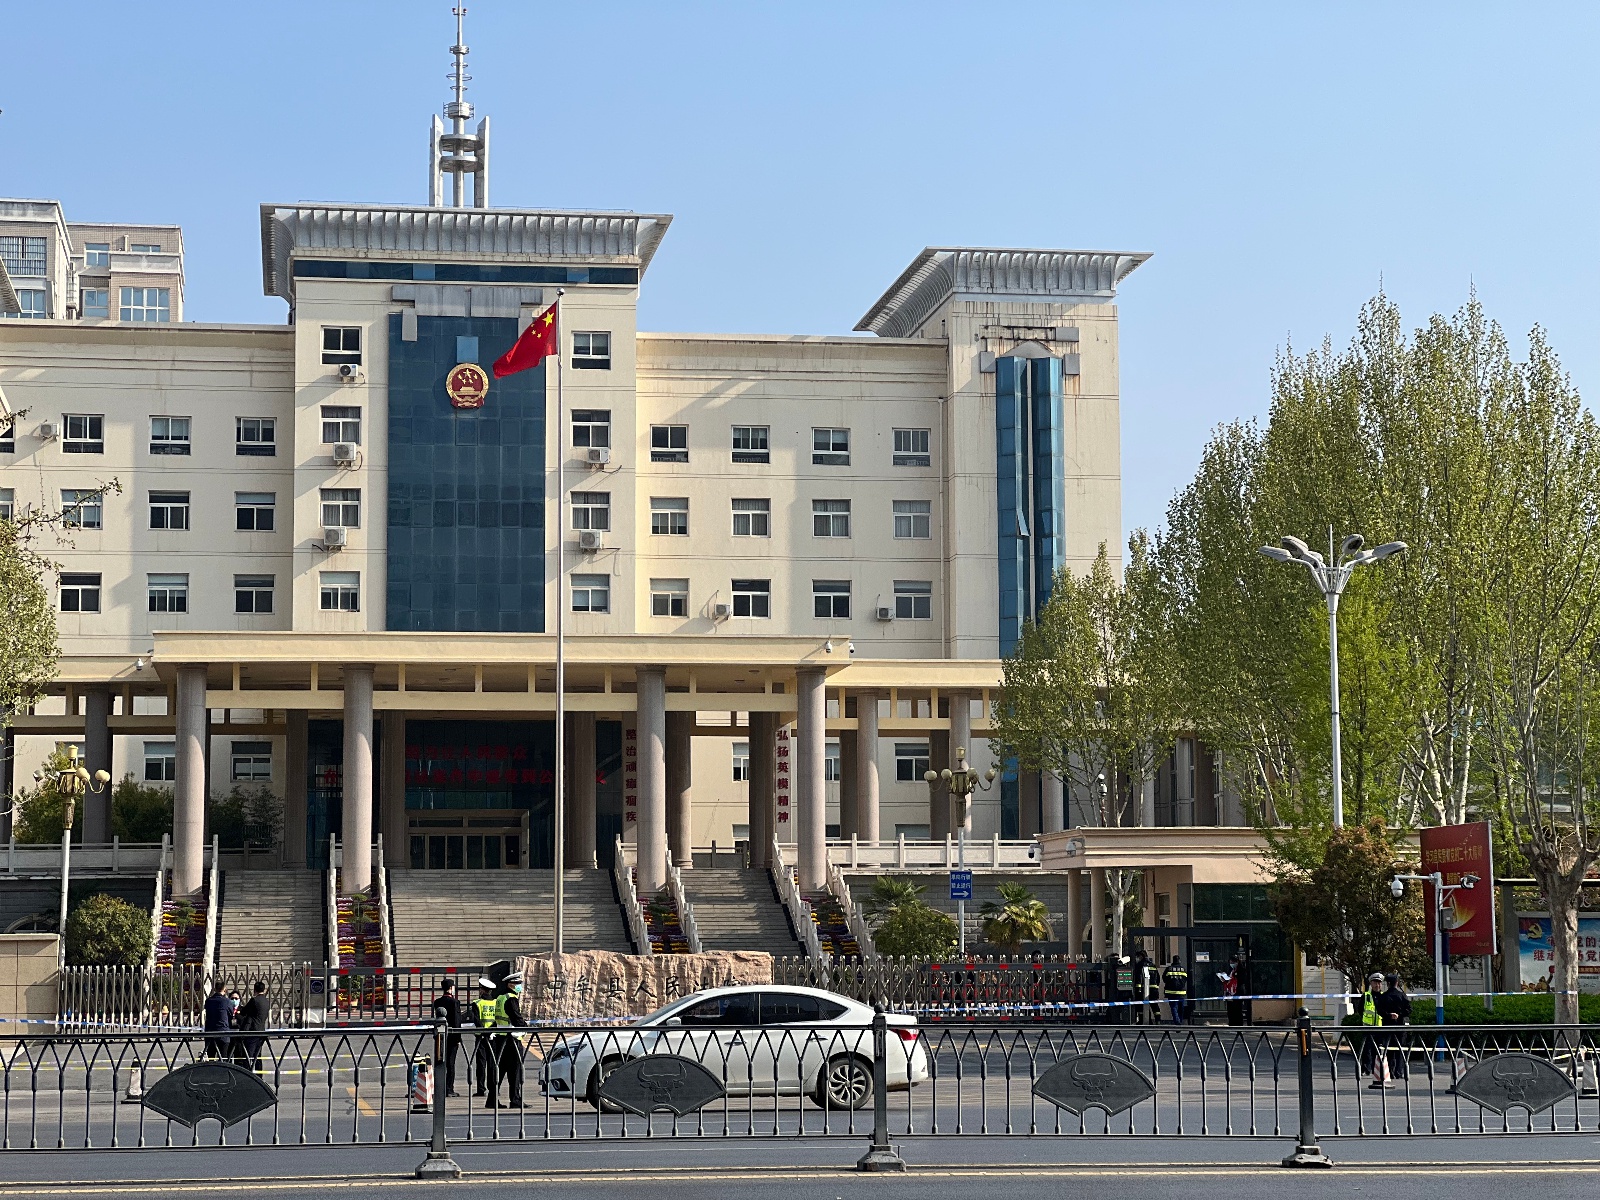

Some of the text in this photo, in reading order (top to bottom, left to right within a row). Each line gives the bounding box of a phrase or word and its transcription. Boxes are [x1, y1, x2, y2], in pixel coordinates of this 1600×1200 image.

[777, 730, 789, 823] 弘扬英模精神
